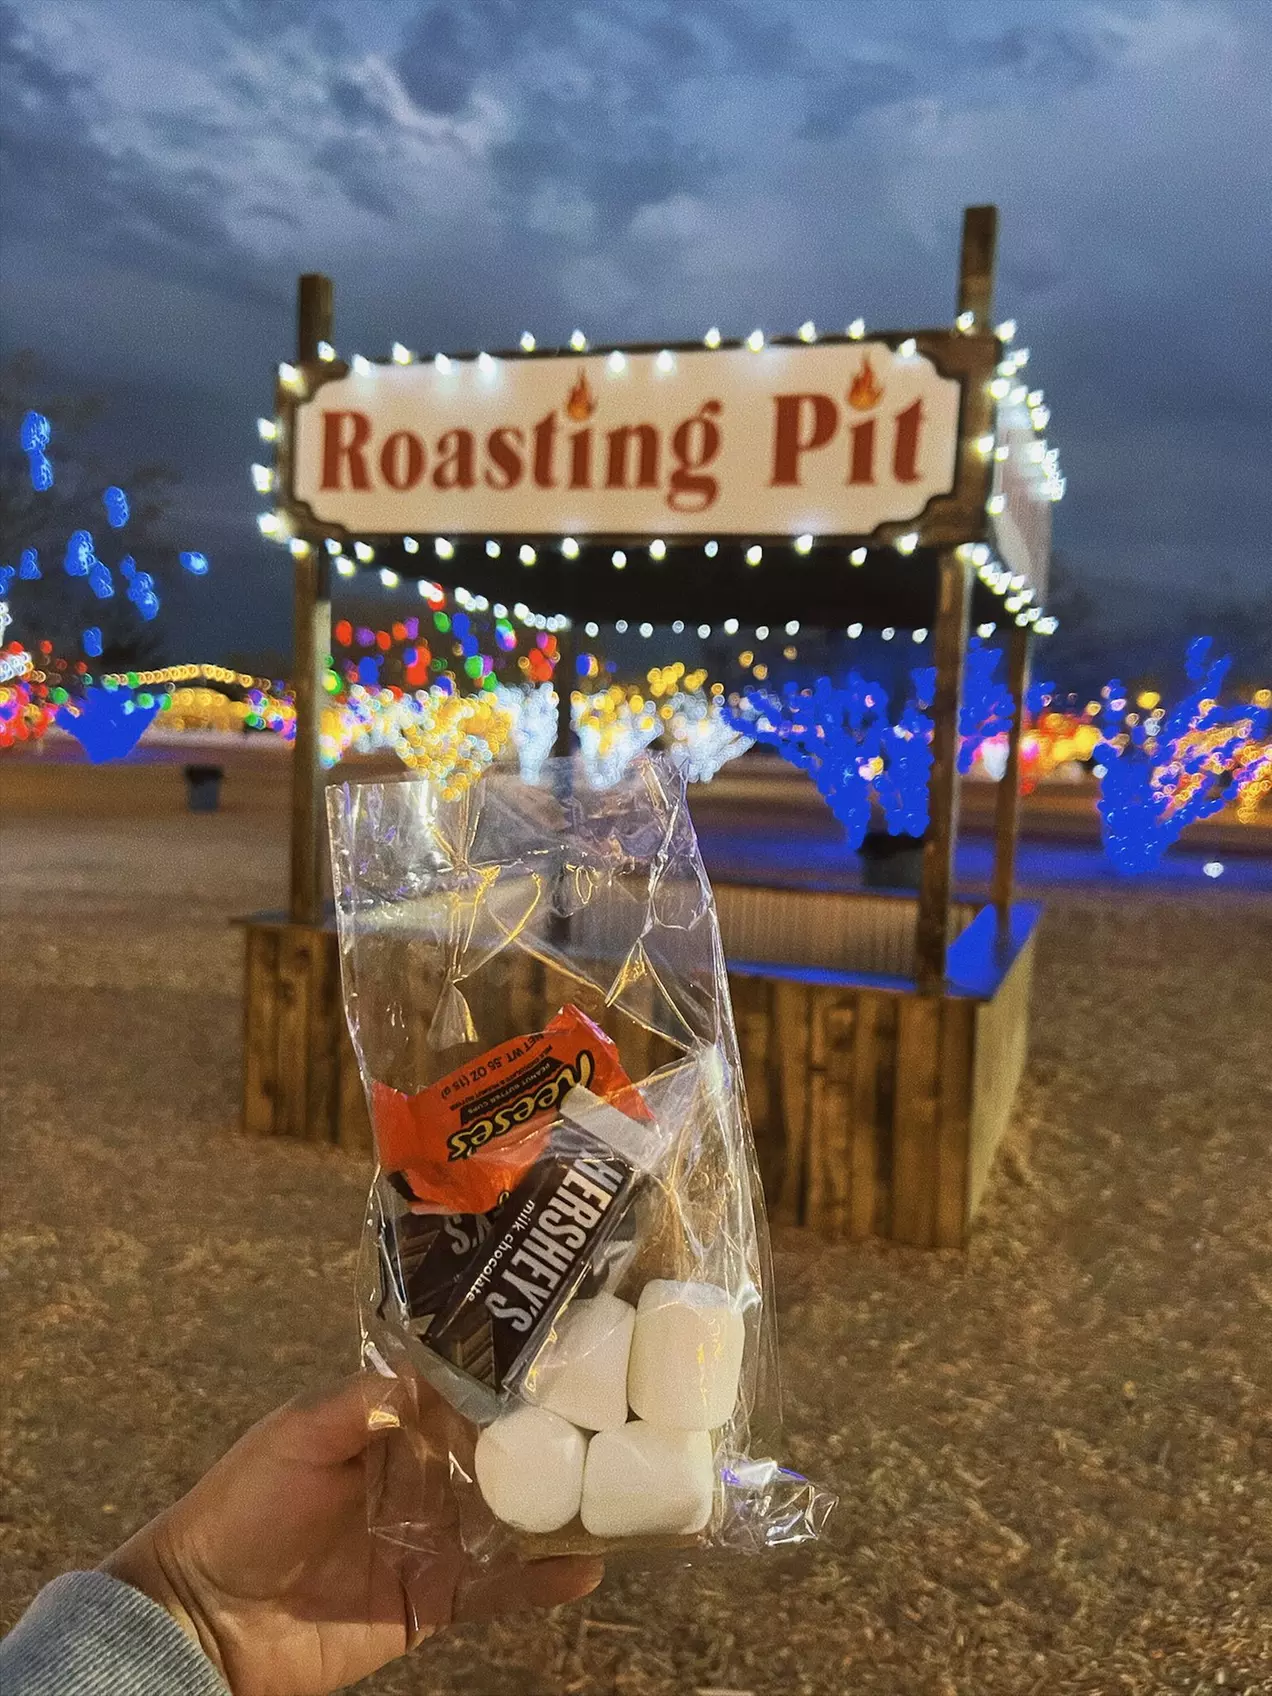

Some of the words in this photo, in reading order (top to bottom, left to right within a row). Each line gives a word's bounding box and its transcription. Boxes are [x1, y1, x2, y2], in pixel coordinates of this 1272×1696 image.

[320, 399, 723, 513] Roasting
[769, 391, 926, 487] Pit
[523, 1034, 544, 1052] NET
[506, 1048, 524, 1063] WT
[469, 1066, 488, 1081] OZ
[522, 1062, 550, 1086] PEANUT
[489, 1083, 521, 1104] BUTTER
[467, 1101, 489, 1114] CUPS
[512, 1199, 535, 1232] milk
[485, 1152, 624, 1332] HERSHEY'S
[468, 1233, 514, 1302] chocolate
